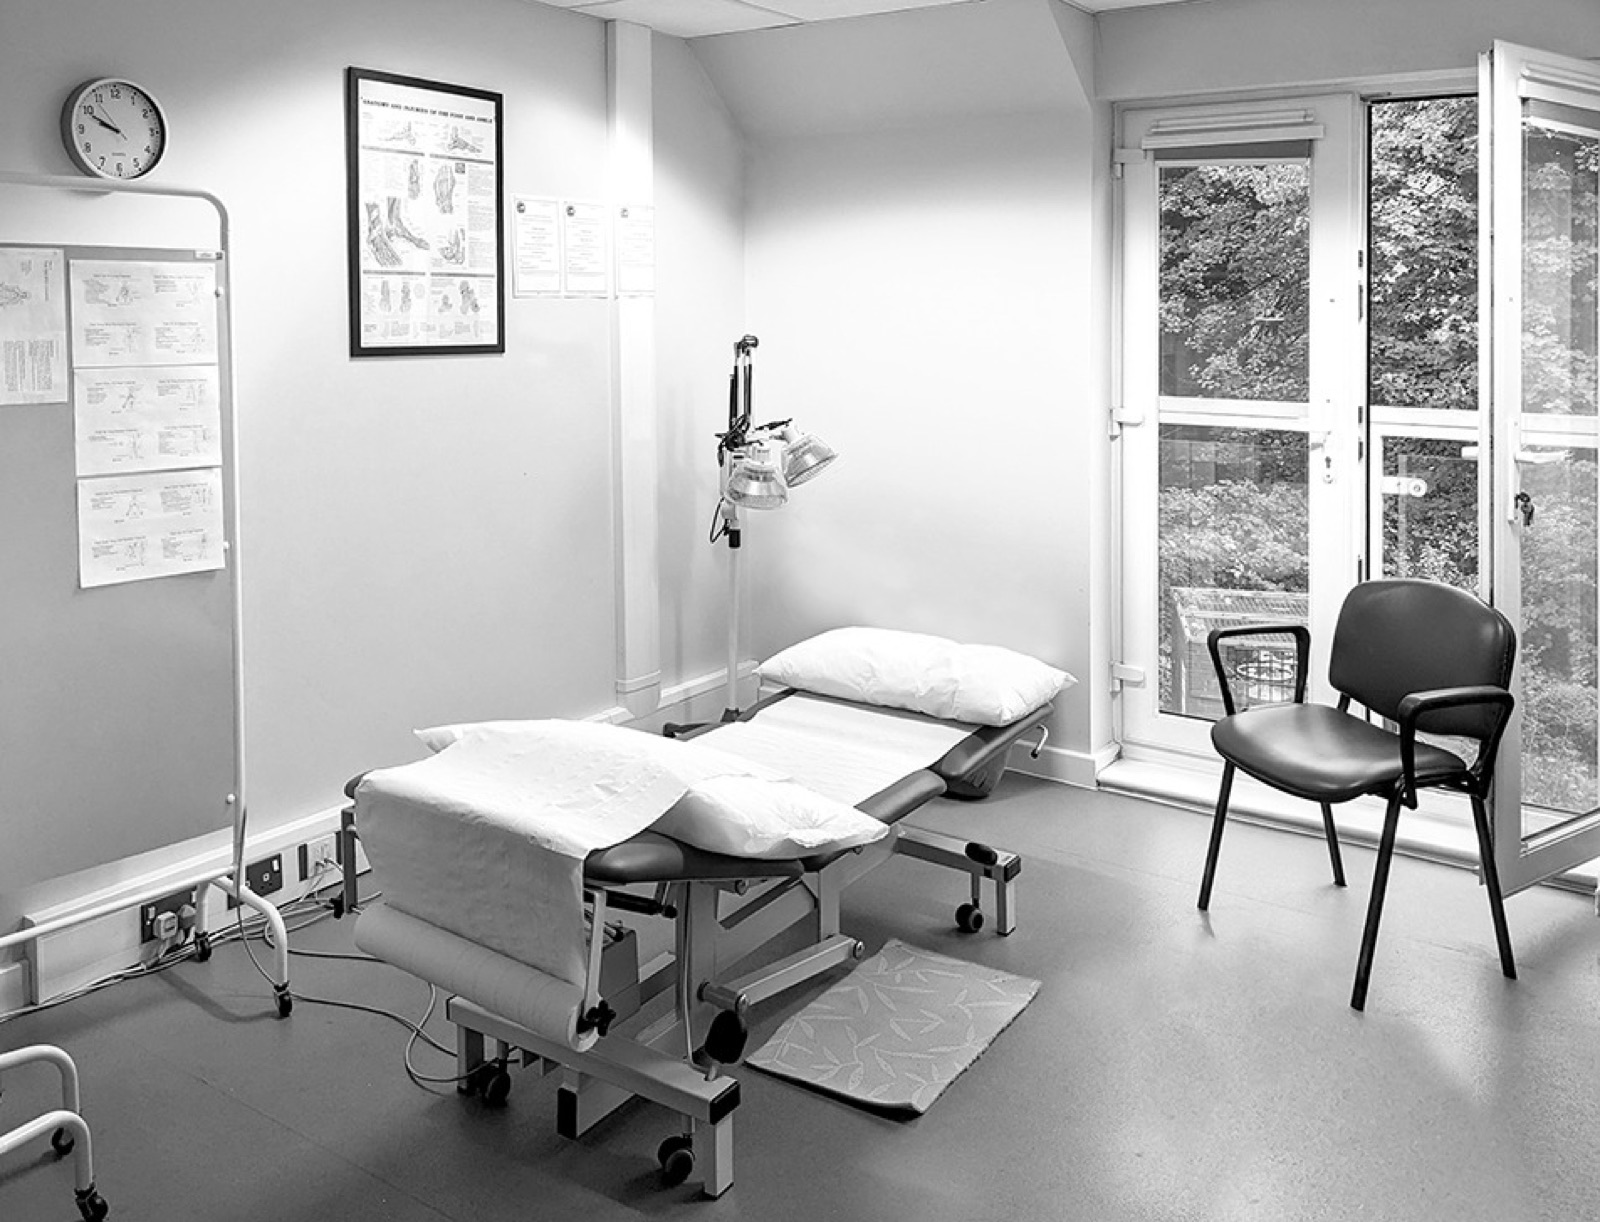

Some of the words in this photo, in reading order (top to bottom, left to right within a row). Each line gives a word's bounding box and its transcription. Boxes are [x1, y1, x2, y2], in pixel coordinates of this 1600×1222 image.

[95, 93, 103, 103] 11
[110, 88, 121, 99] 12
[131, 95, 135, 106] 1
[83, 105, 94, 115] 10
[142, 108, 149, 119] 2
[78, 124, 85, 134] 9
[149, 127, 155, 137] 3
[84, 142, 92, 153] 8
[144, 145, 151, 154] 4
[99, 156, 106, 166] 7
[133, 157, 140, 168] 5
[116, 162, 123, 172] 6
